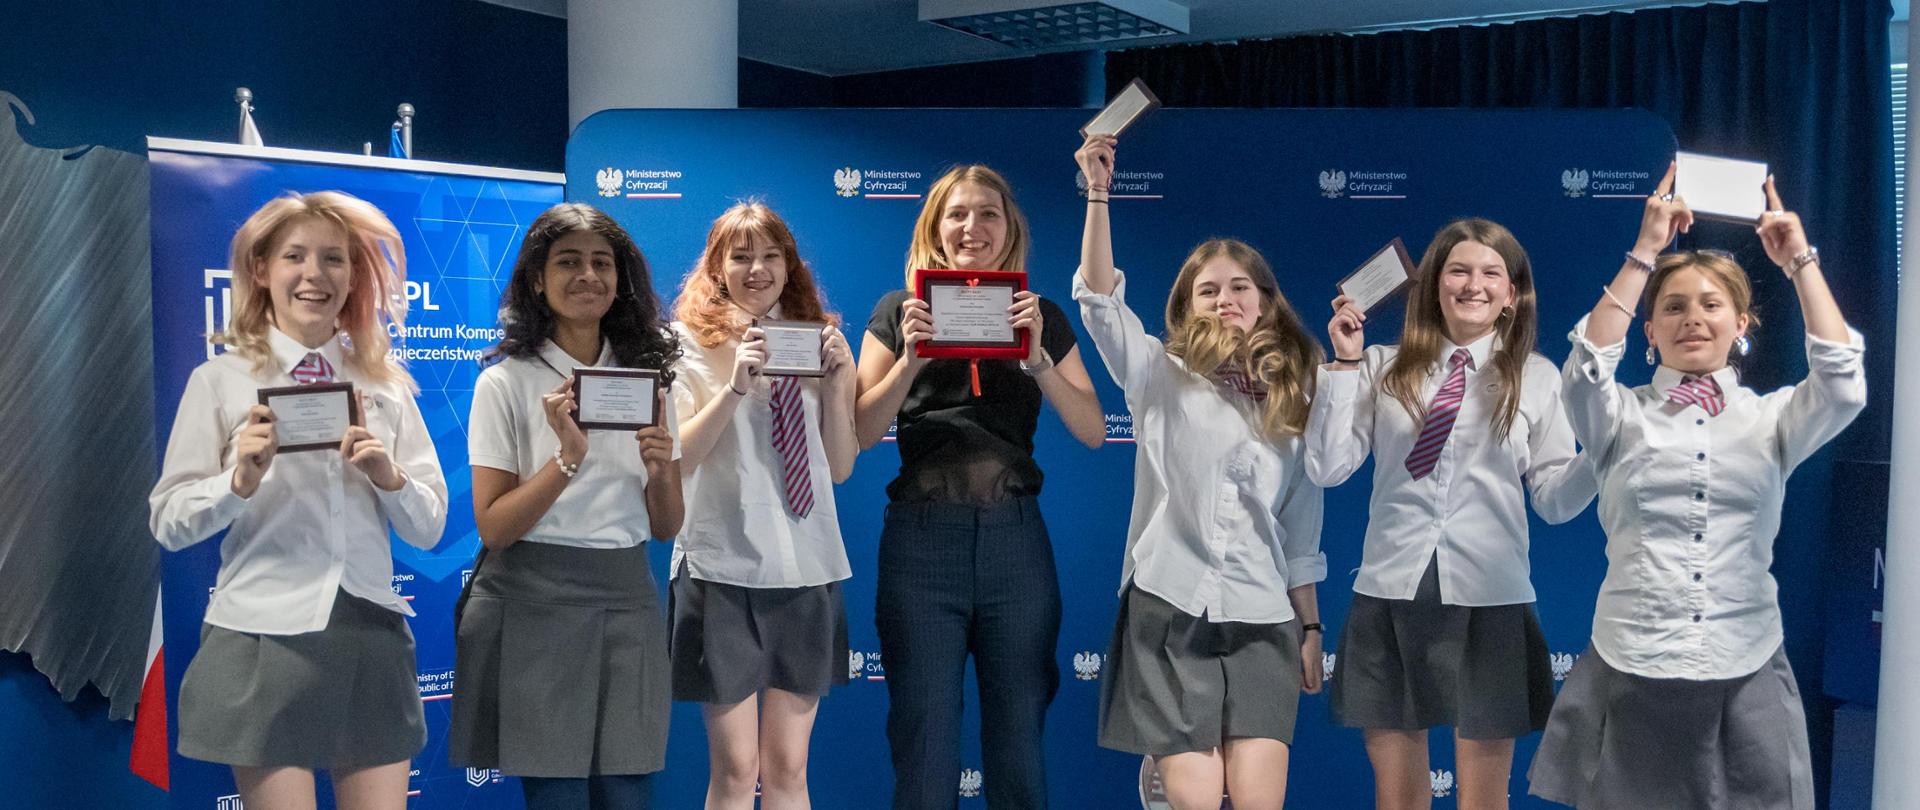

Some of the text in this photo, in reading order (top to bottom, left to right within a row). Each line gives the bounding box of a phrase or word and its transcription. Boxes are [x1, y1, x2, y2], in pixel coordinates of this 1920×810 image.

[626, 169, 682, 178] Ministerstwo
[864, 170, 921, 179] Ministerstwo
[1349, 171, 1407, 180] Ministerstwo
[1592, 170, 1649, 179] Ministerstwo
[626, 180, 668, 190] Cyfryzacji
[864, 181, 907, 191] Cyfryzacji
[1111, 182, 1150, 192] yfryzacji
[1349, 182, 1393, 192] Cyfryzacji
[1592, 181, 1635, 191] Cyfryzacji
[440, 671, 448, 680] of
[441, 681, 449, 690] of
